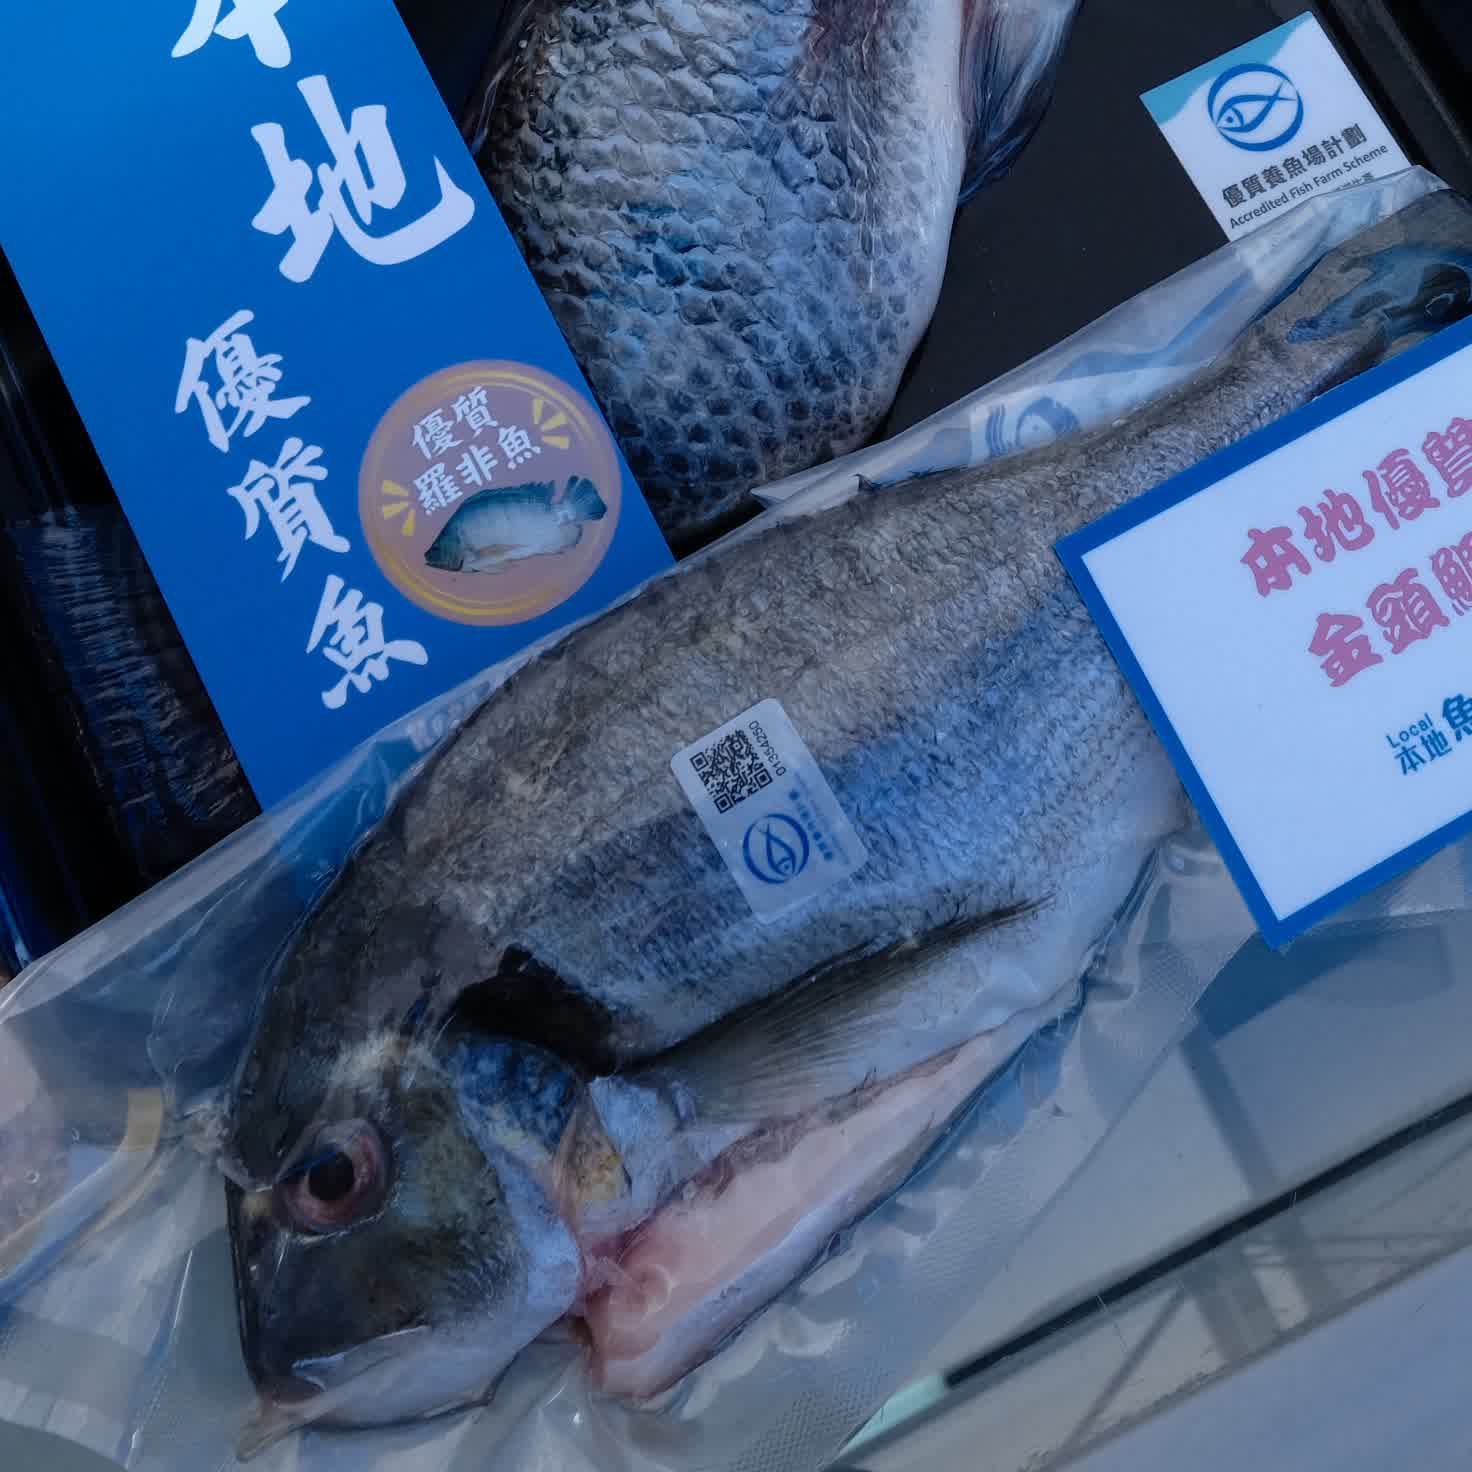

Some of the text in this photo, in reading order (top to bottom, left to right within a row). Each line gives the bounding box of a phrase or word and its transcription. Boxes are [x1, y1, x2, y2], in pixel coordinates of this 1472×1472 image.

[1221, 123, 1368, 209] 優質養魚場計劃
[1229, 191, 1290, 229] Accredited
[1289, 179, 1314, 199] Fish
[1313, 162, 1343, 188] Farm
[1343, 143, 1389, 173] Scheme
[412, 385, 499, 460] 優質
[174, 310, 429, 711] 優質魚
[413, 424, 542, 516] 羅非魚
[748, 719, 787, 778] 01354250
[1386, 712, 1435, 750] Local
